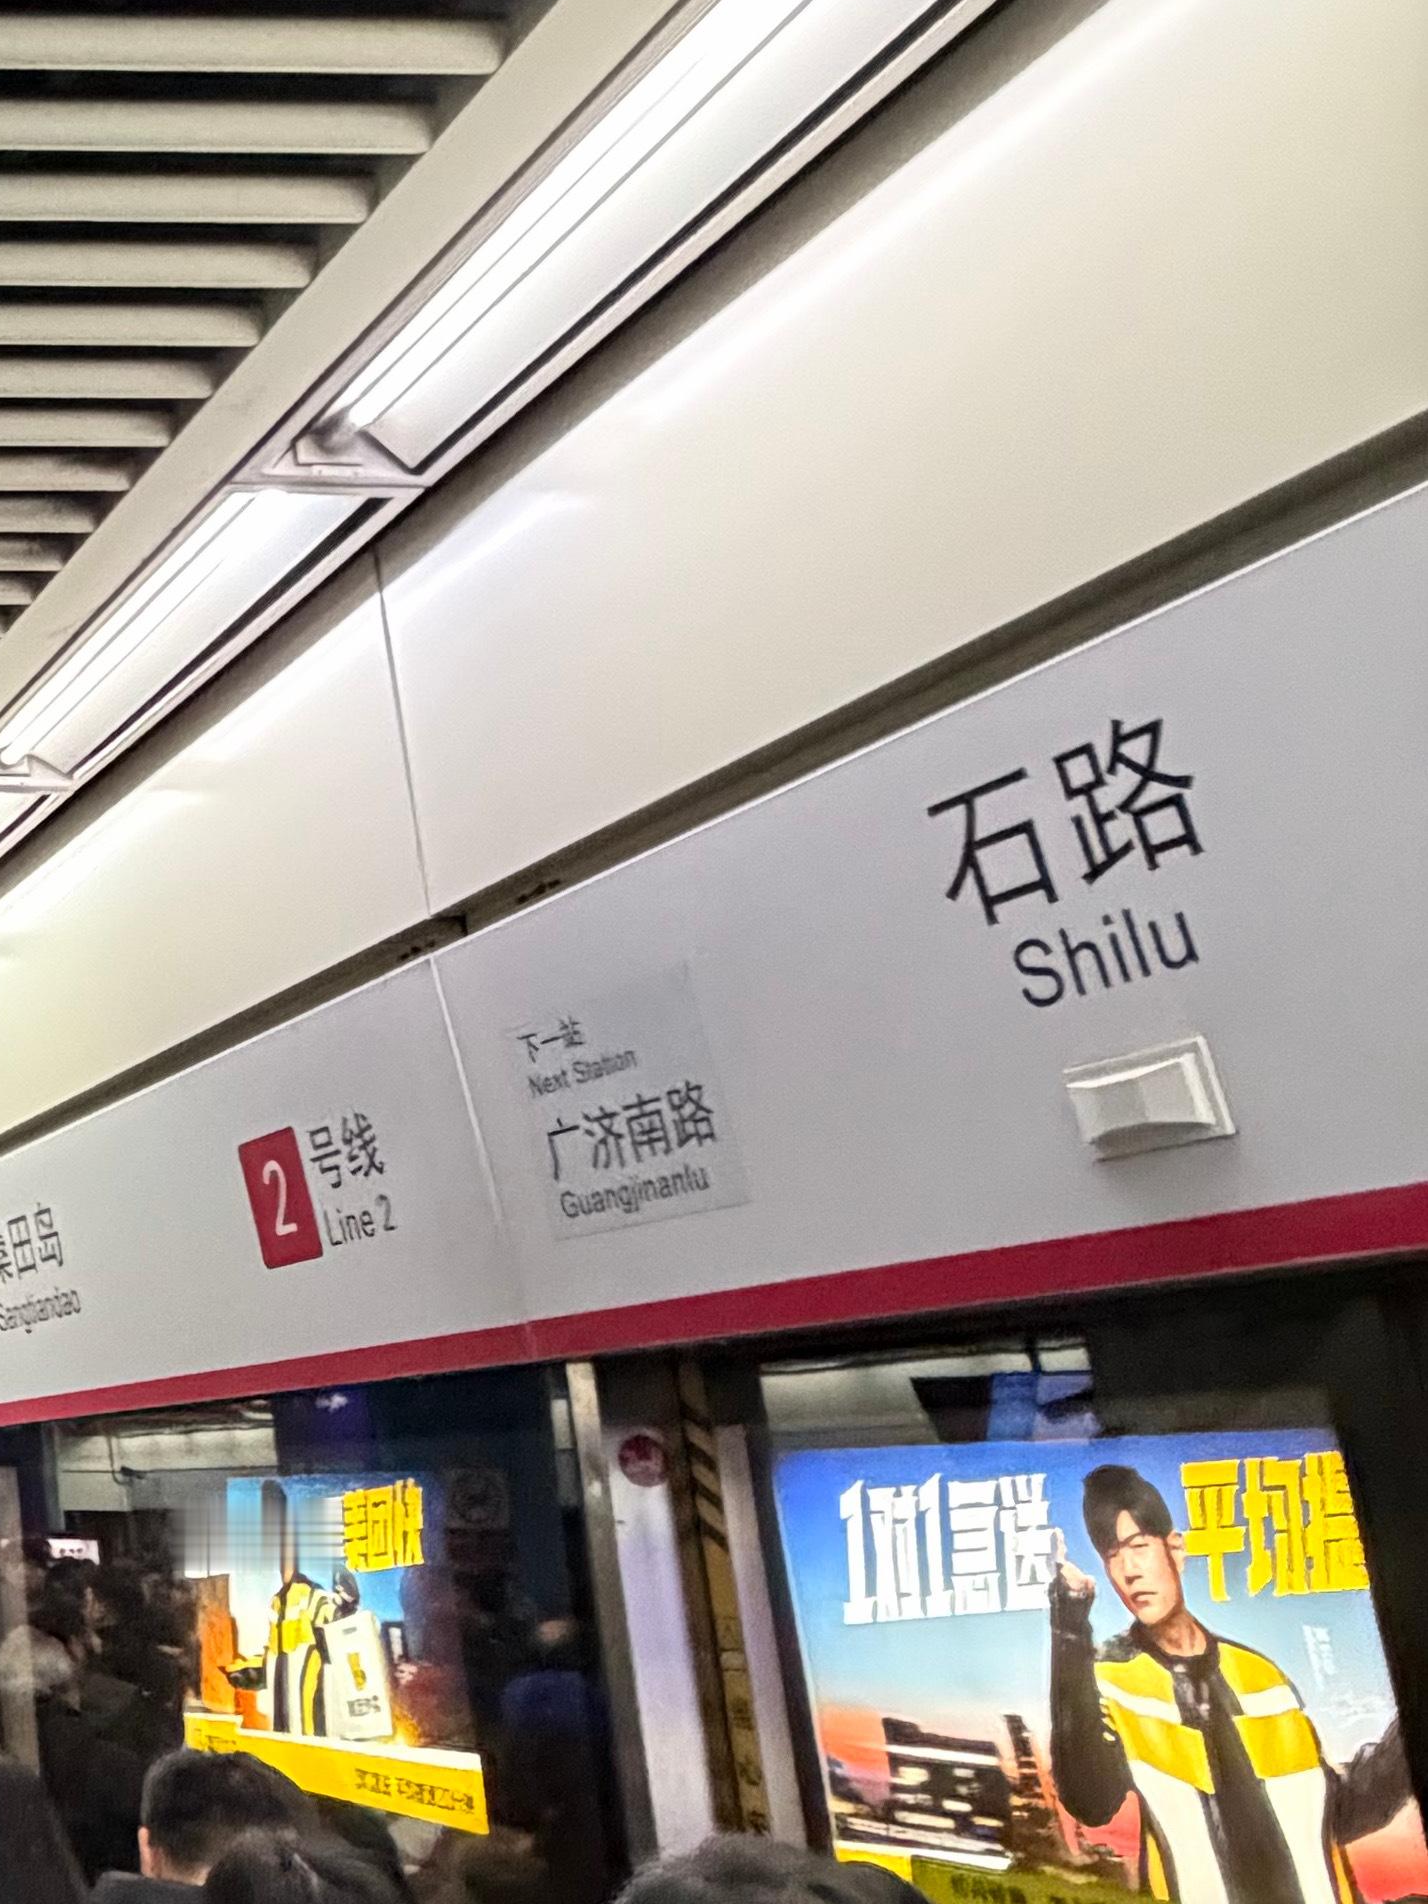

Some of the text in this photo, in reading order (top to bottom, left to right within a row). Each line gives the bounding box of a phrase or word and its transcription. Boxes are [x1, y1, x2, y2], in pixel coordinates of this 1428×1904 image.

[927, 718, 1205, 926] 石路
[1012, 907, 1200, 1008] Shilu
[516, 1014, 586, 1064] 下一站
[528, 1049, 639, 1097] Next Station
[546, 1080, 718, 1182] 广济南路
[261, 1110, 385, 1236] 2 号线
[559, 1163, 711, 1219] Guangjinanlu
[323, 1194, 398, 1247] Line 2
